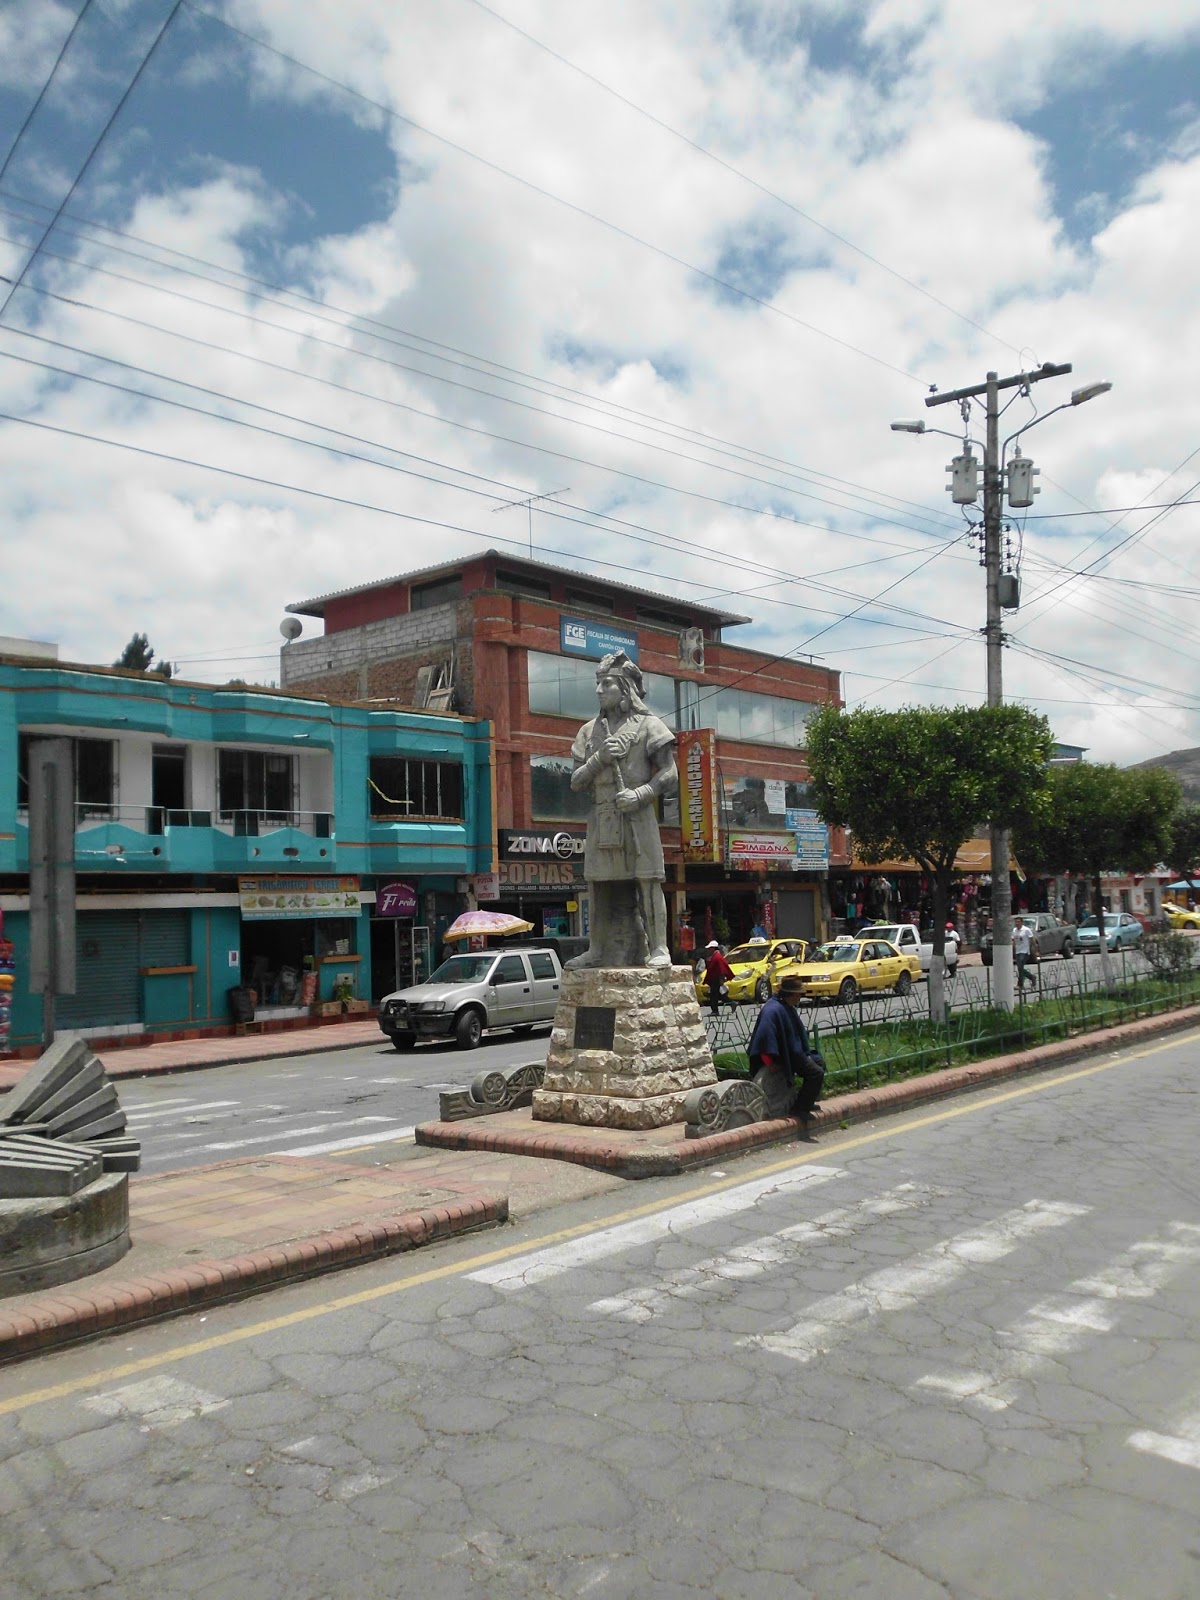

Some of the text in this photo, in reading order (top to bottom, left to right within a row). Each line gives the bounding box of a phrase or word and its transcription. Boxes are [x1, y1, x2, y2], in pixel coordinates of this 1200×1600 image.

[566, 625, 585, 638] FGE
[507, 836, 554, 853] ZONA
[498, 863, 574, 884] COPIAS
